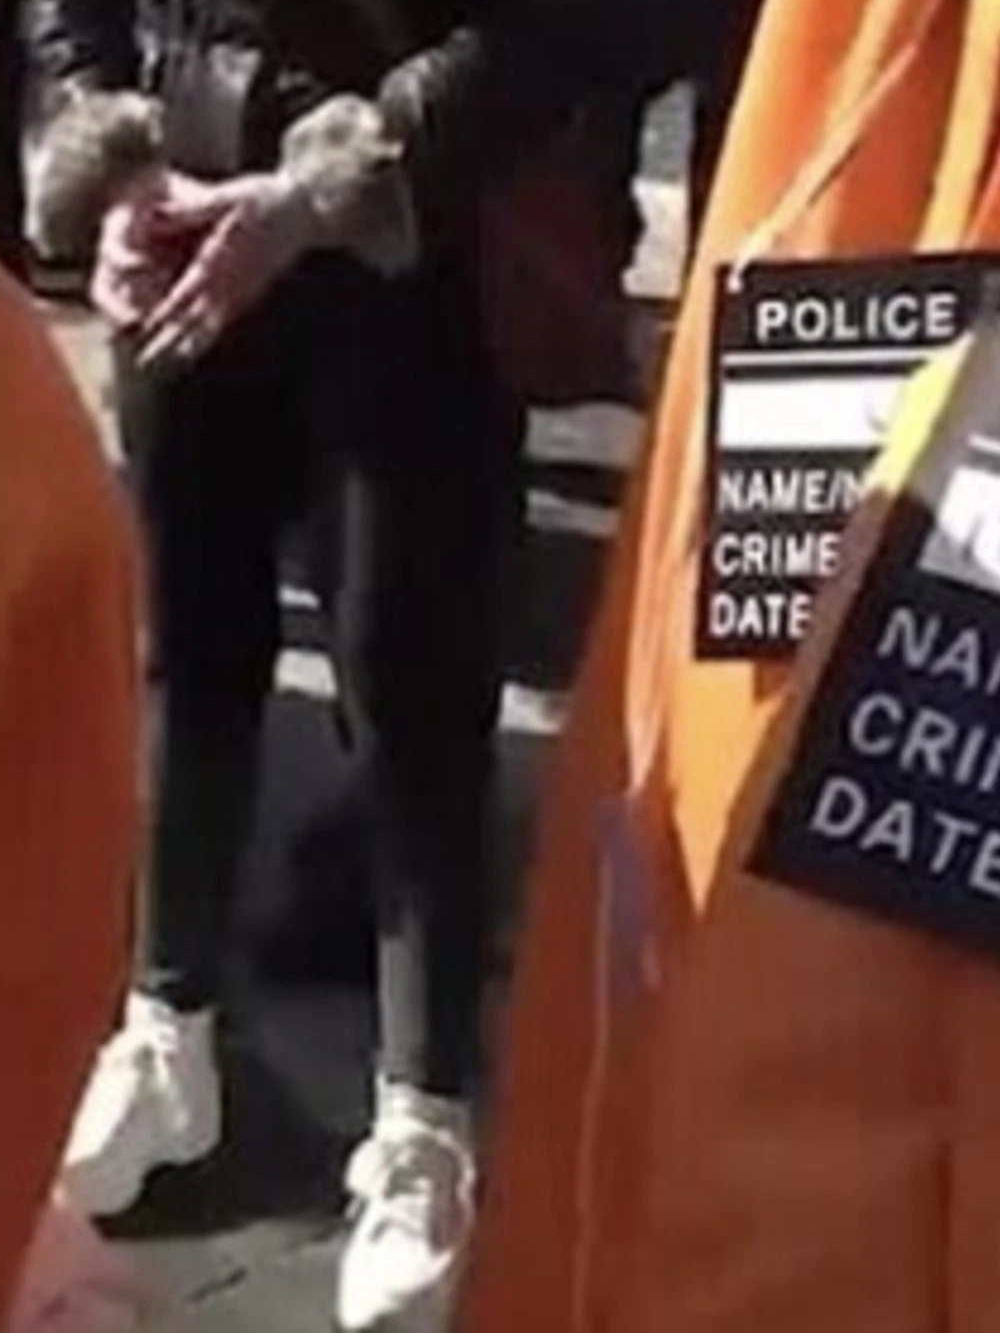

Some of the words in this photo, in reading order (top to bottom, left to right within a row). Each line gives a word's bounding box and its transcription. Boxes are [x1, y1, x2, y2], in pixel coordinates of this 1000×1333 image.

[756, 293, 959, 343] POLICE
[714, 532, 843, 576] CRIME
[708, 594, 814, 639] DATE
[876, 607, 1000, 696] NA
[851, 694, 1000, 792] CRI
[808, 775, 1000, 898] DATE
